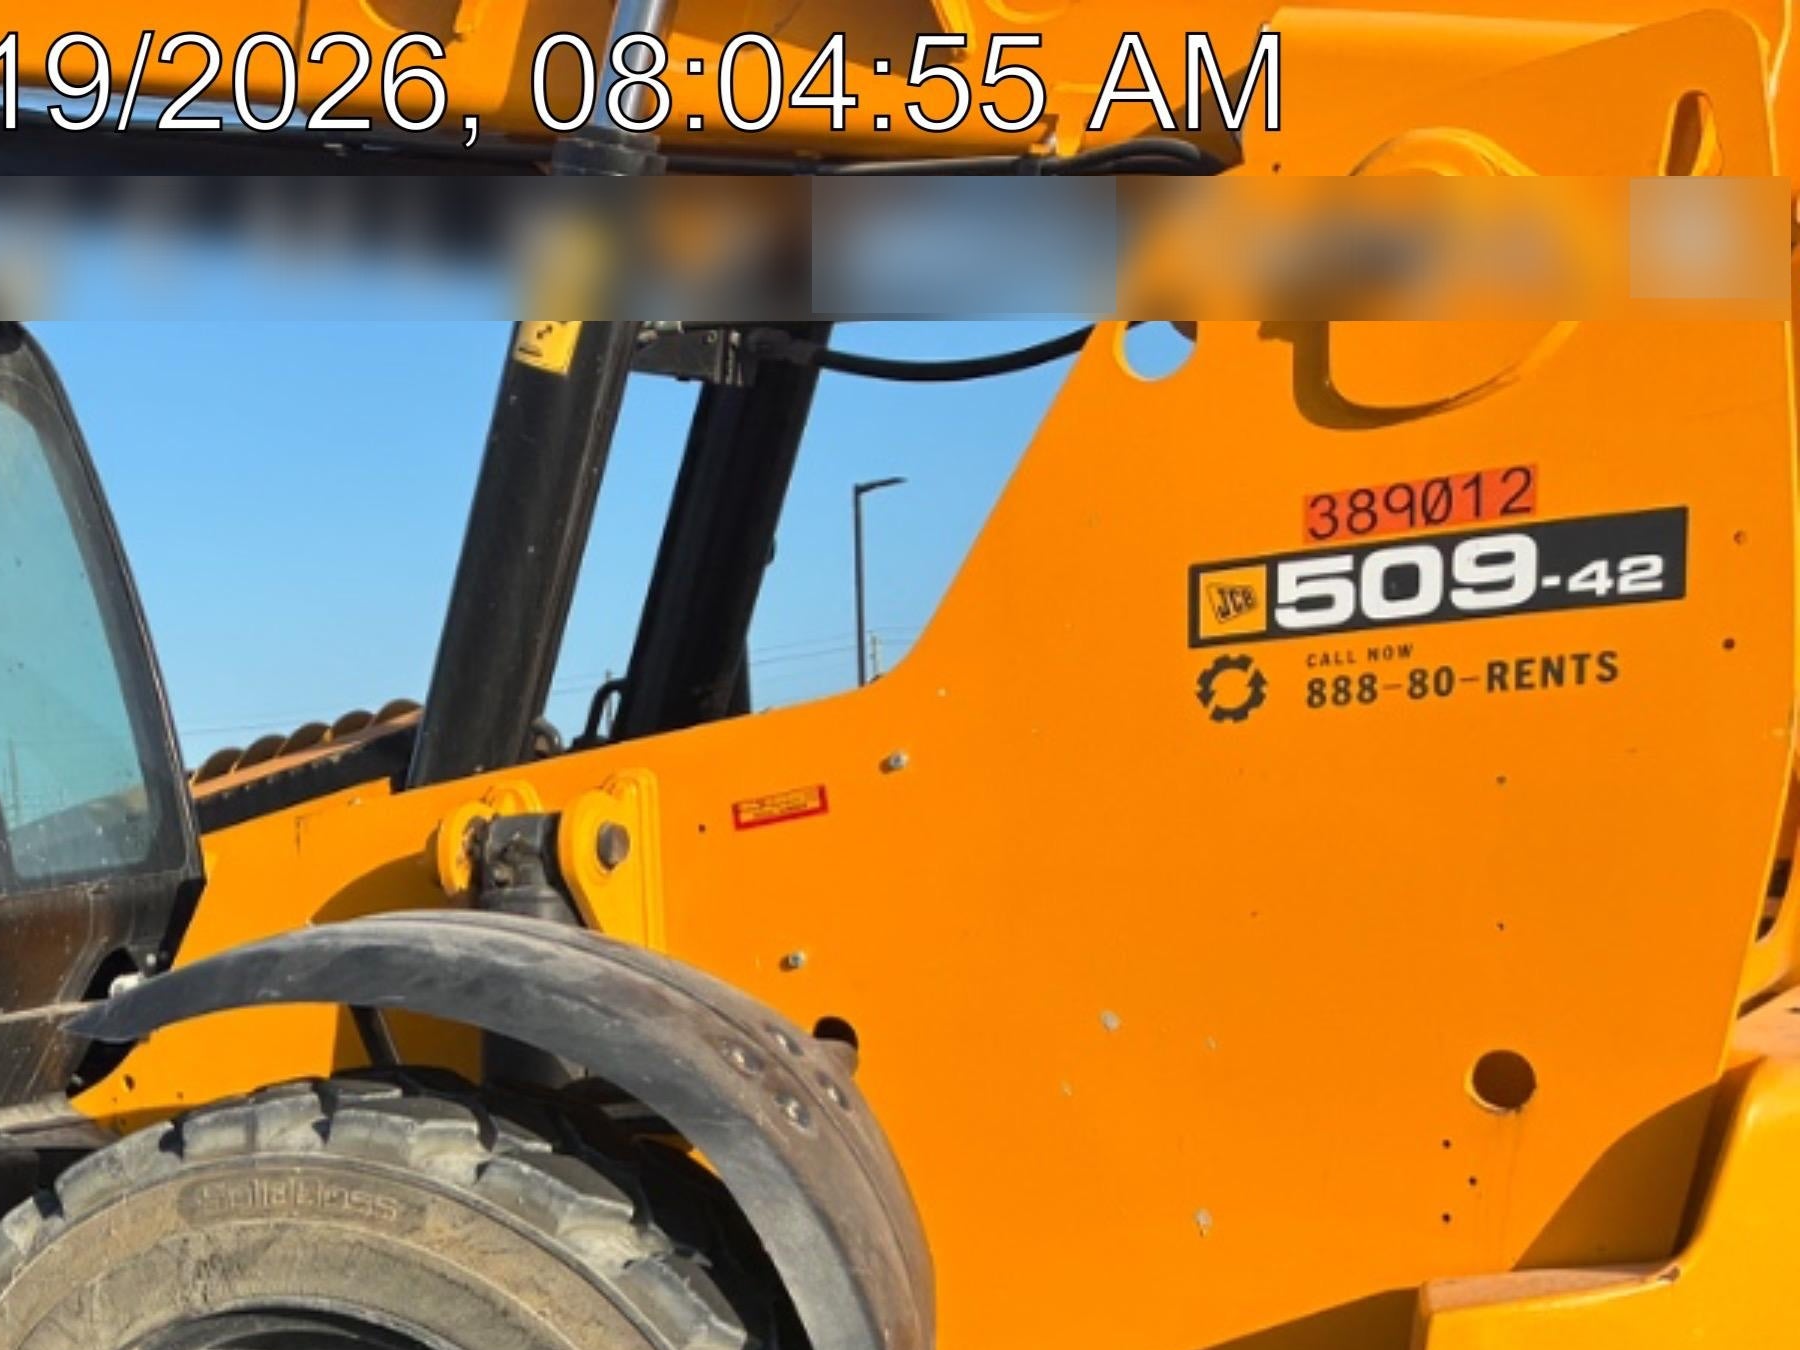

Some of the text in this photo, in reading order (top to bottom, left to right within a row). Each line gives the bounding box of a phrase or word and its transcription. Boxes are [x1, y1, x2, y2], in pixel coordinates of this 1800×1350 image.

[1307, 464, 1534, 541] 389012
[1274, 532, 1665, 631] 509-42
[1305, 643, 1415, 668] CALL NOW
[1305, 650, 1620, 709] 888-80-RENTS
